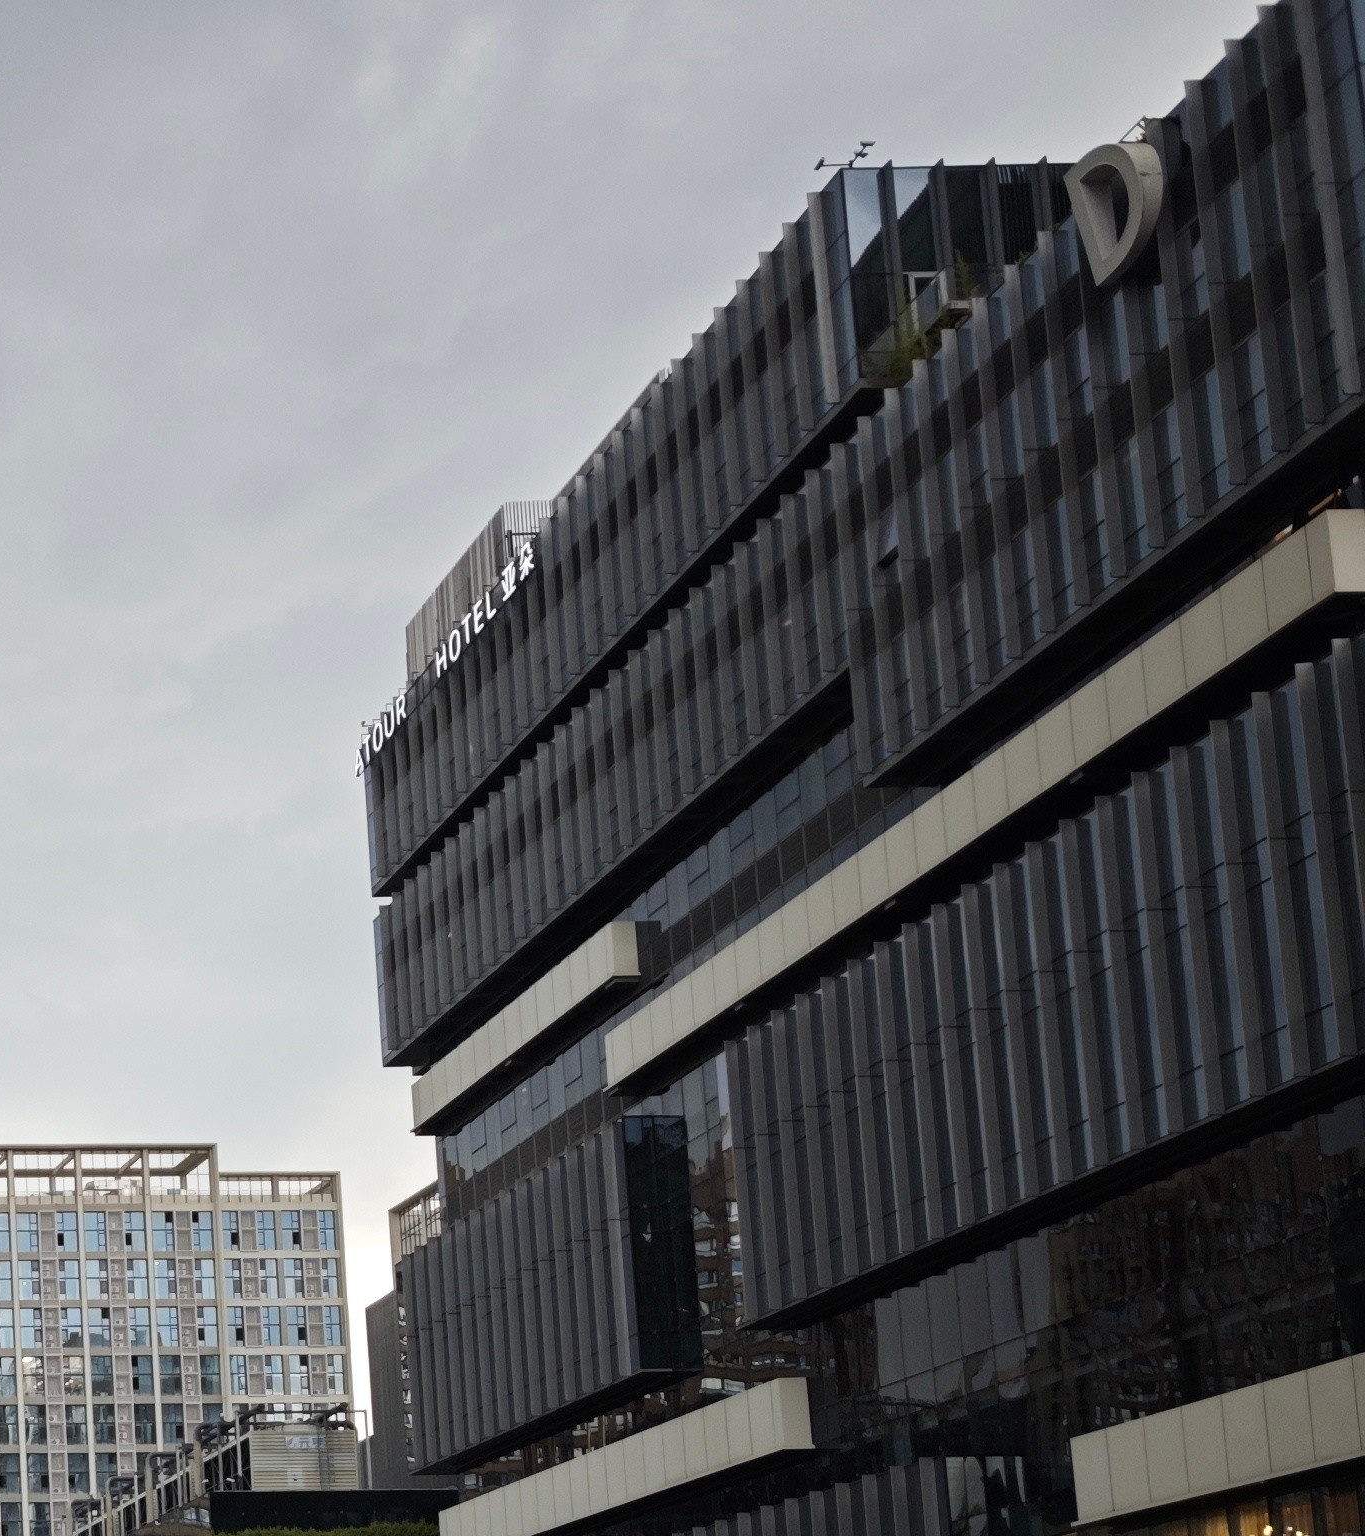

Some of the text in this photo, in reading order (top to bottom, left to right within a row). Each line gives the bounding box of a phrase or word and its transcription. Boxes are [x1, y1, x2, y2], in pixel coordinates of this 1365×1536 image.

[1064, 141, 1164, 287] D
[501, 541, 535, 602] 亚朵
[355, 591, 497, 778] ATOUR HOTEL
